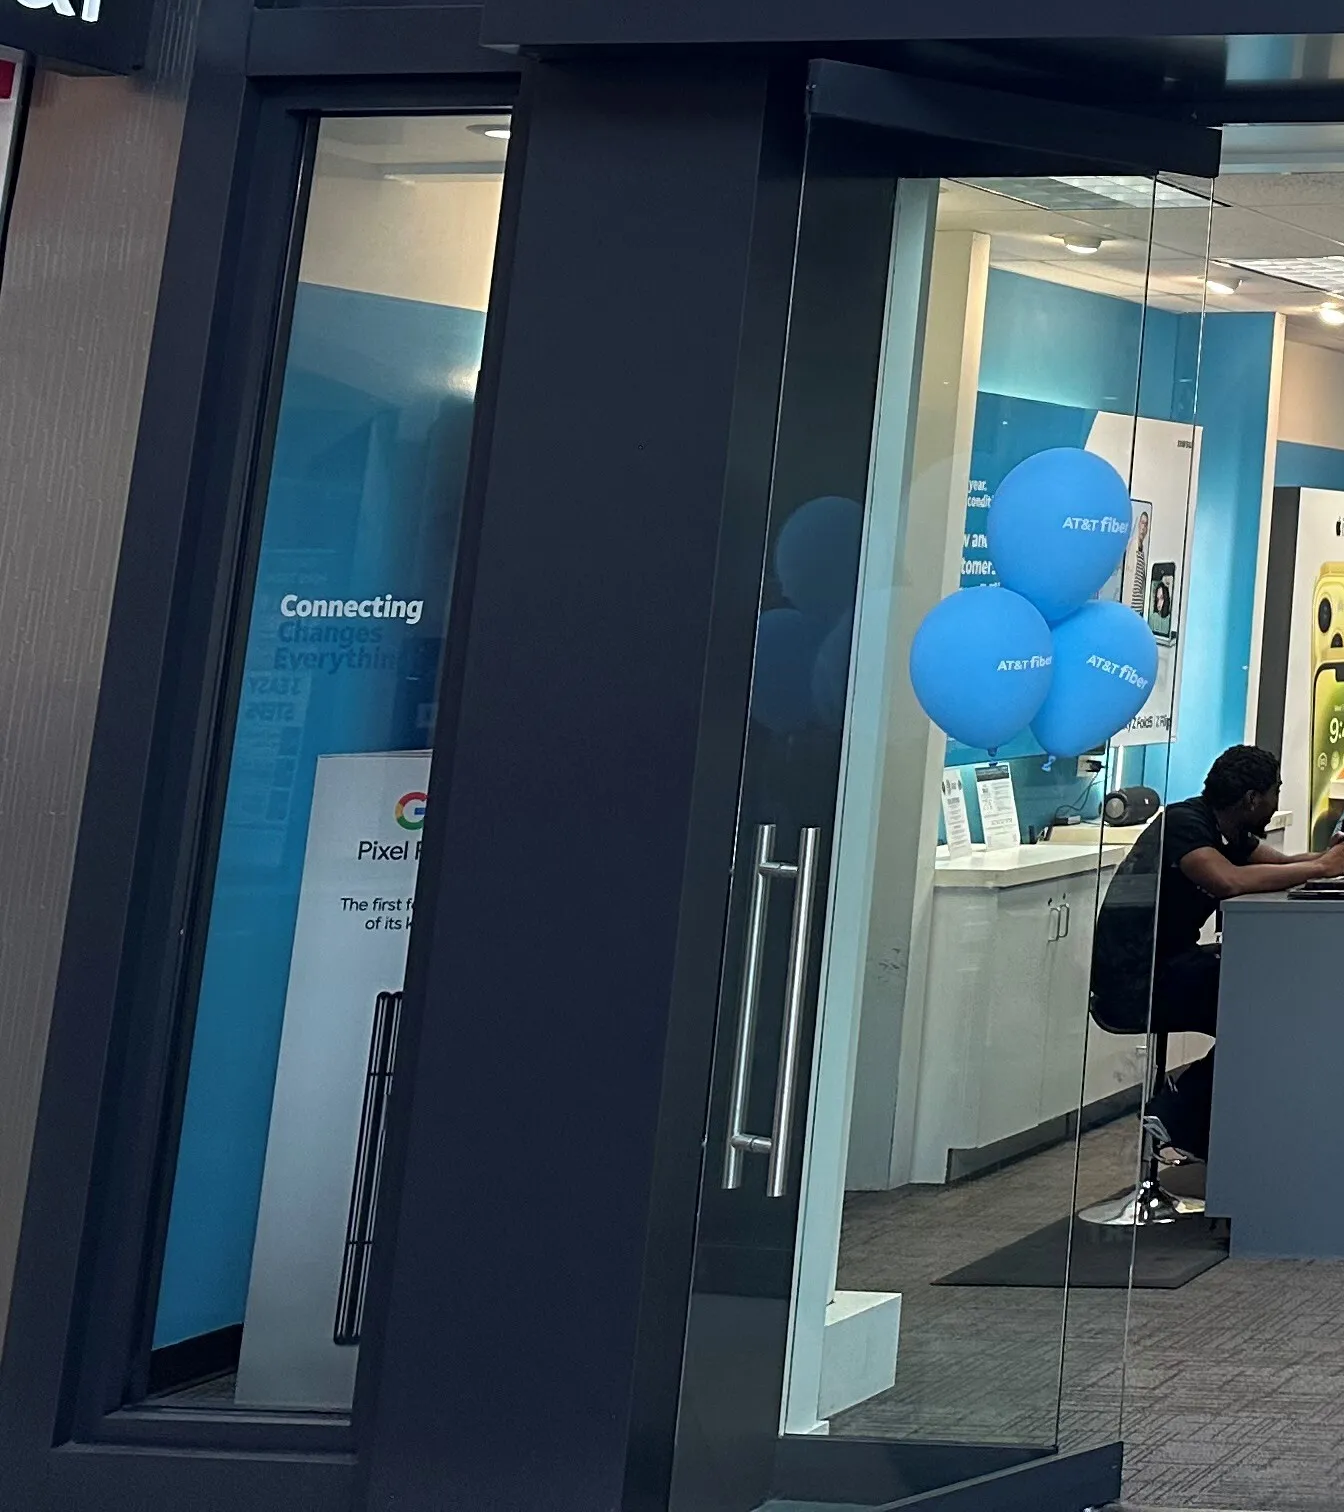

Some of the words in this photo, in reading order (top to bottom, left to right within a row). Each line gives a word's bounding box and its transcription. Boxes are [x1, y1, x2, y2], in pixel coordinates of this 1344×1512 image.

[1062, 517, 1099, 532] AT&T
[1100, 516, 1129, 534] fiber
[280, 593, 425, 625] Connecting
[273, 646, 396, 675] Everythin
[996, 659, 1029, 672] AT&T
[1086, 654, 1120, 675] AT&T
[1118, 664, 1149, 690] fiber
[357, 840, 409, 861] Pixel
[340, 897, 369, 912] The
[372, 897, 403, 912] first
[365, 916, 382, 931] of
[384, 916, 402, 931] its
